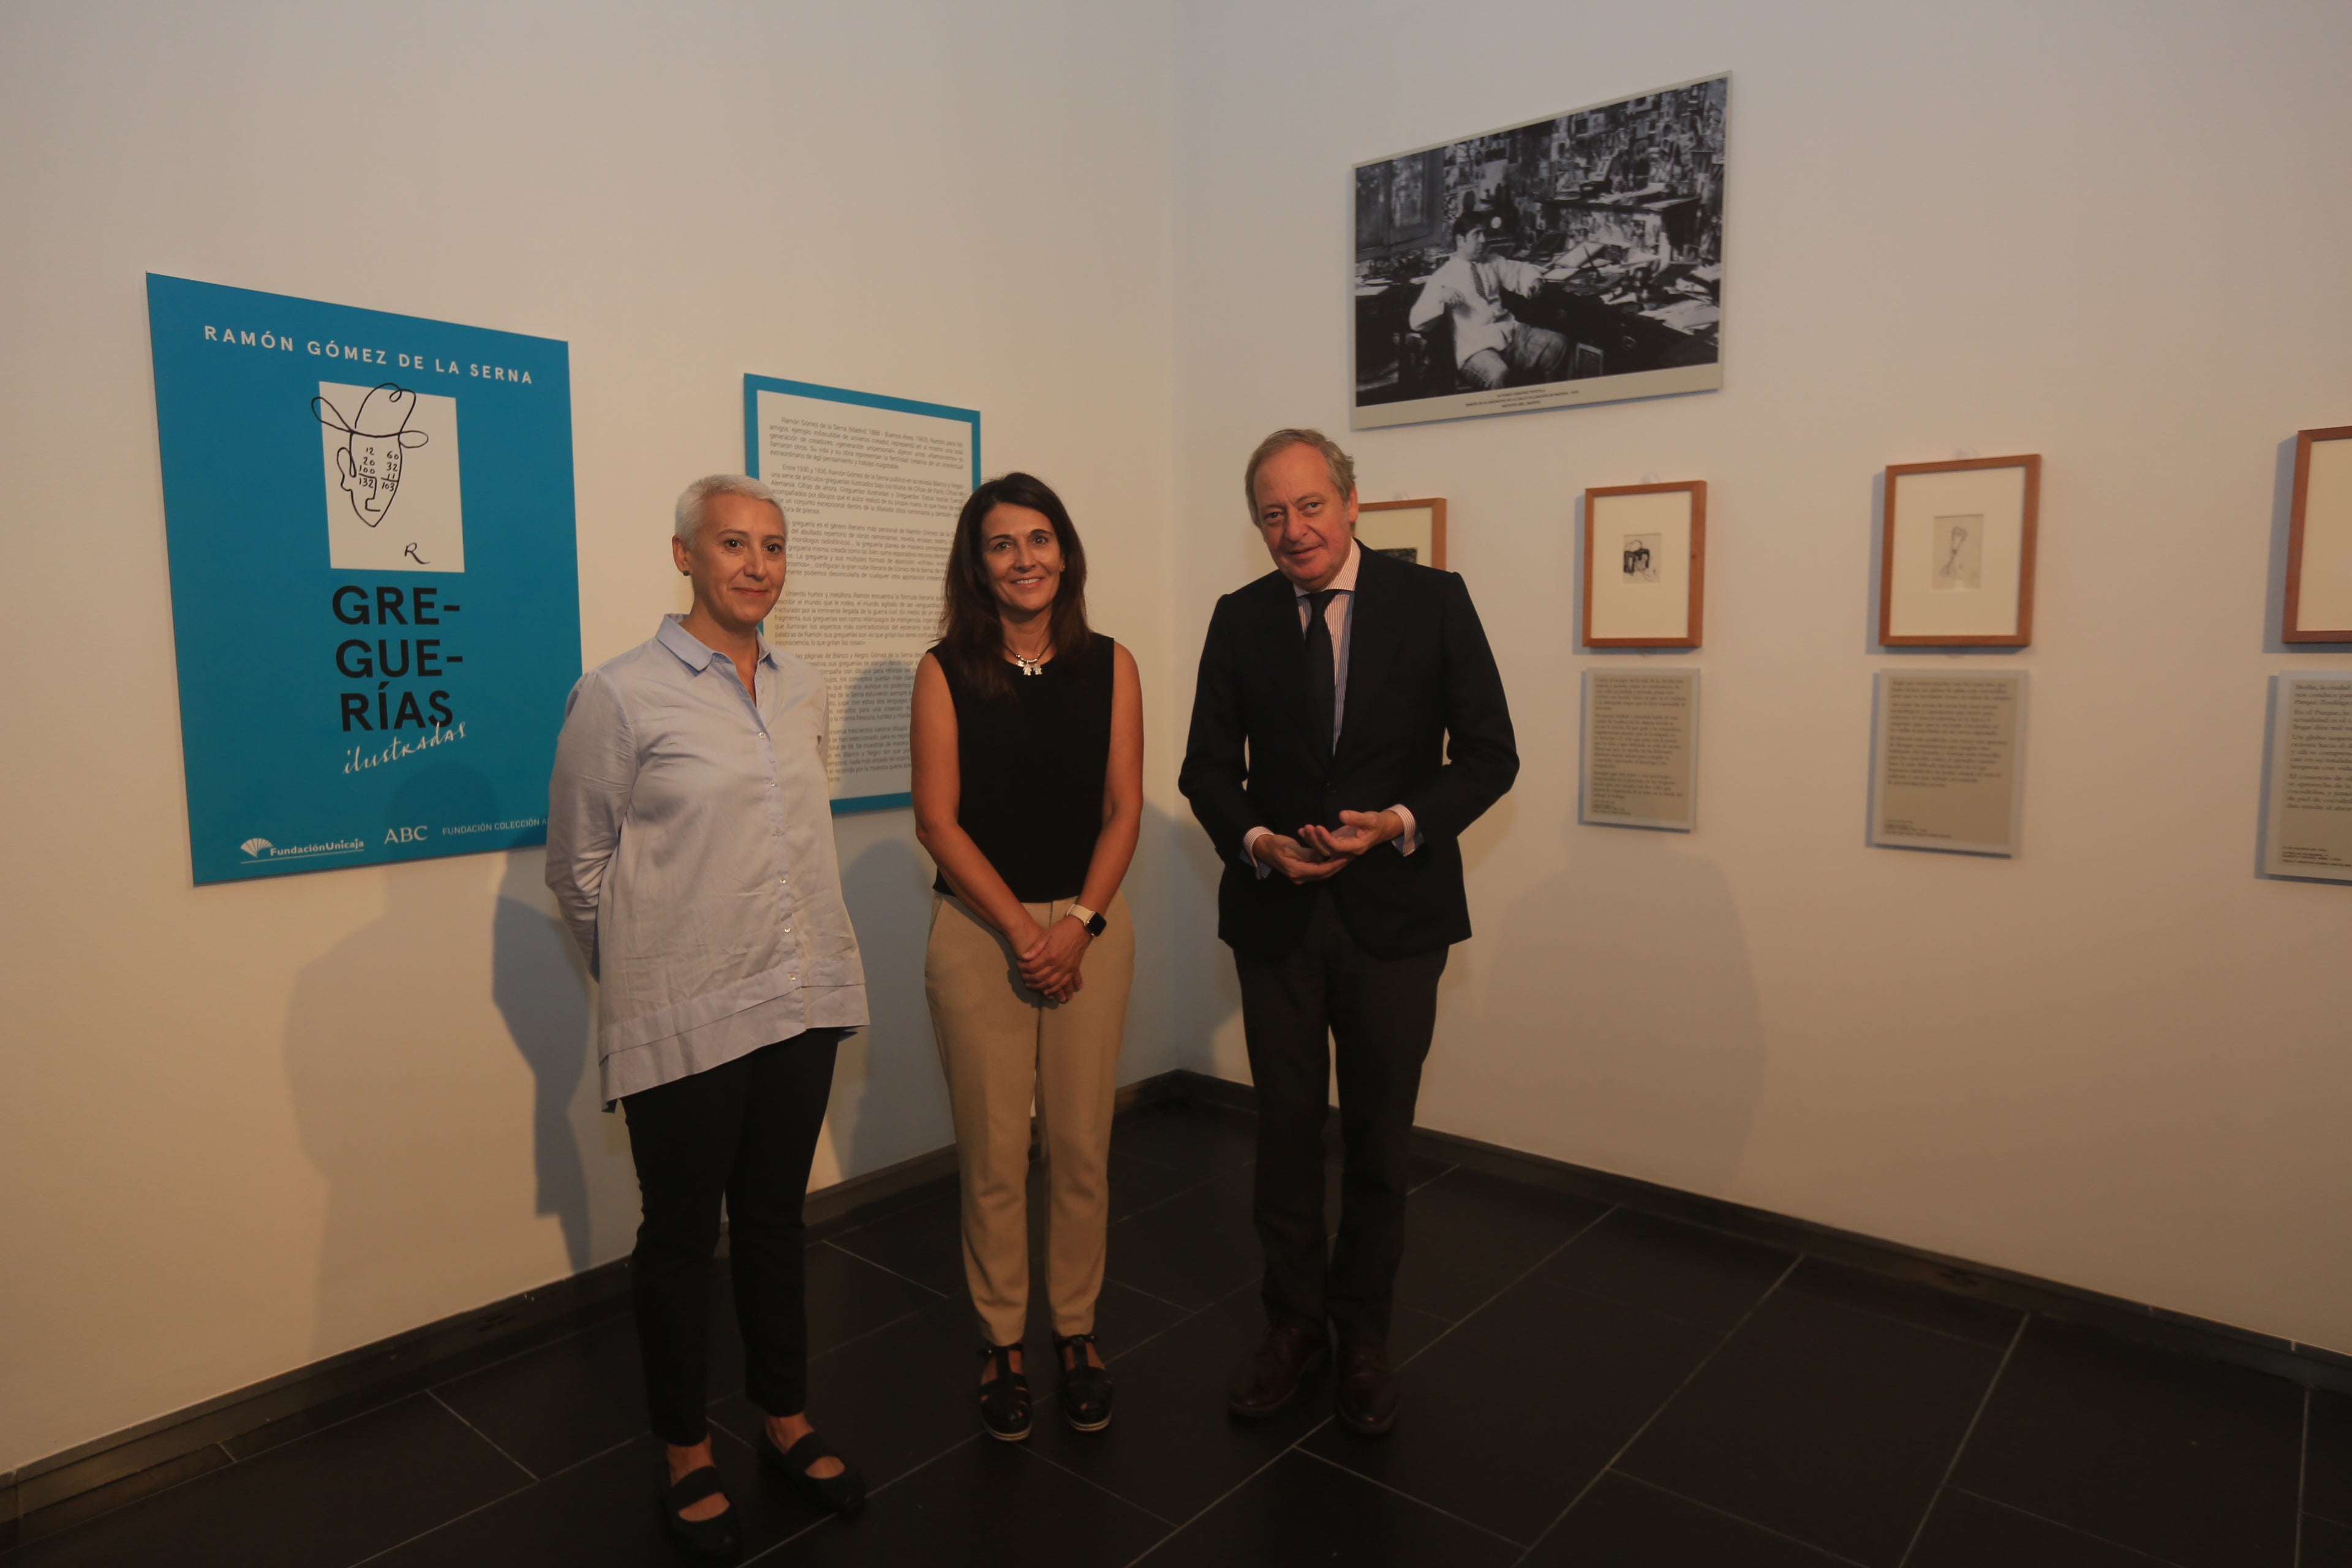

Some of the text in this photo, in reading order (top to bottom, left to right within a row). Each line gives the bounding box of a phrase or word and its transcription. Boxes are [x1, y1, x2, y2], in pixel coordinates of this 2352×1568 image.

[205, 325, 532, 384] RAMÓN GÓMEZ DE LA SERNA
[363, 456, 375, 466] 20
[386, 451, 399, 460] 60
[359, 464, 375, 474] 100
[386, 462, 398, 472] 32
[359, 478, 374, 488] 132
[382, 482, 395, 492] 103
[404, 542, 430, 564] R
[332, 585, 460, 625] GRE-
[336, 639, 463, 678] GUE-
[341, 681, 453, 732] RÍAS
[342, 721, 466, 774] ilustradas
[384, 825, 428, 845] ABC
[442, 822, 492, 835] FUNDACIÓN
[494, 818, 540, 831] COLECCIÓN
[270, 839, 364, 856] FundaciónUnicaja
